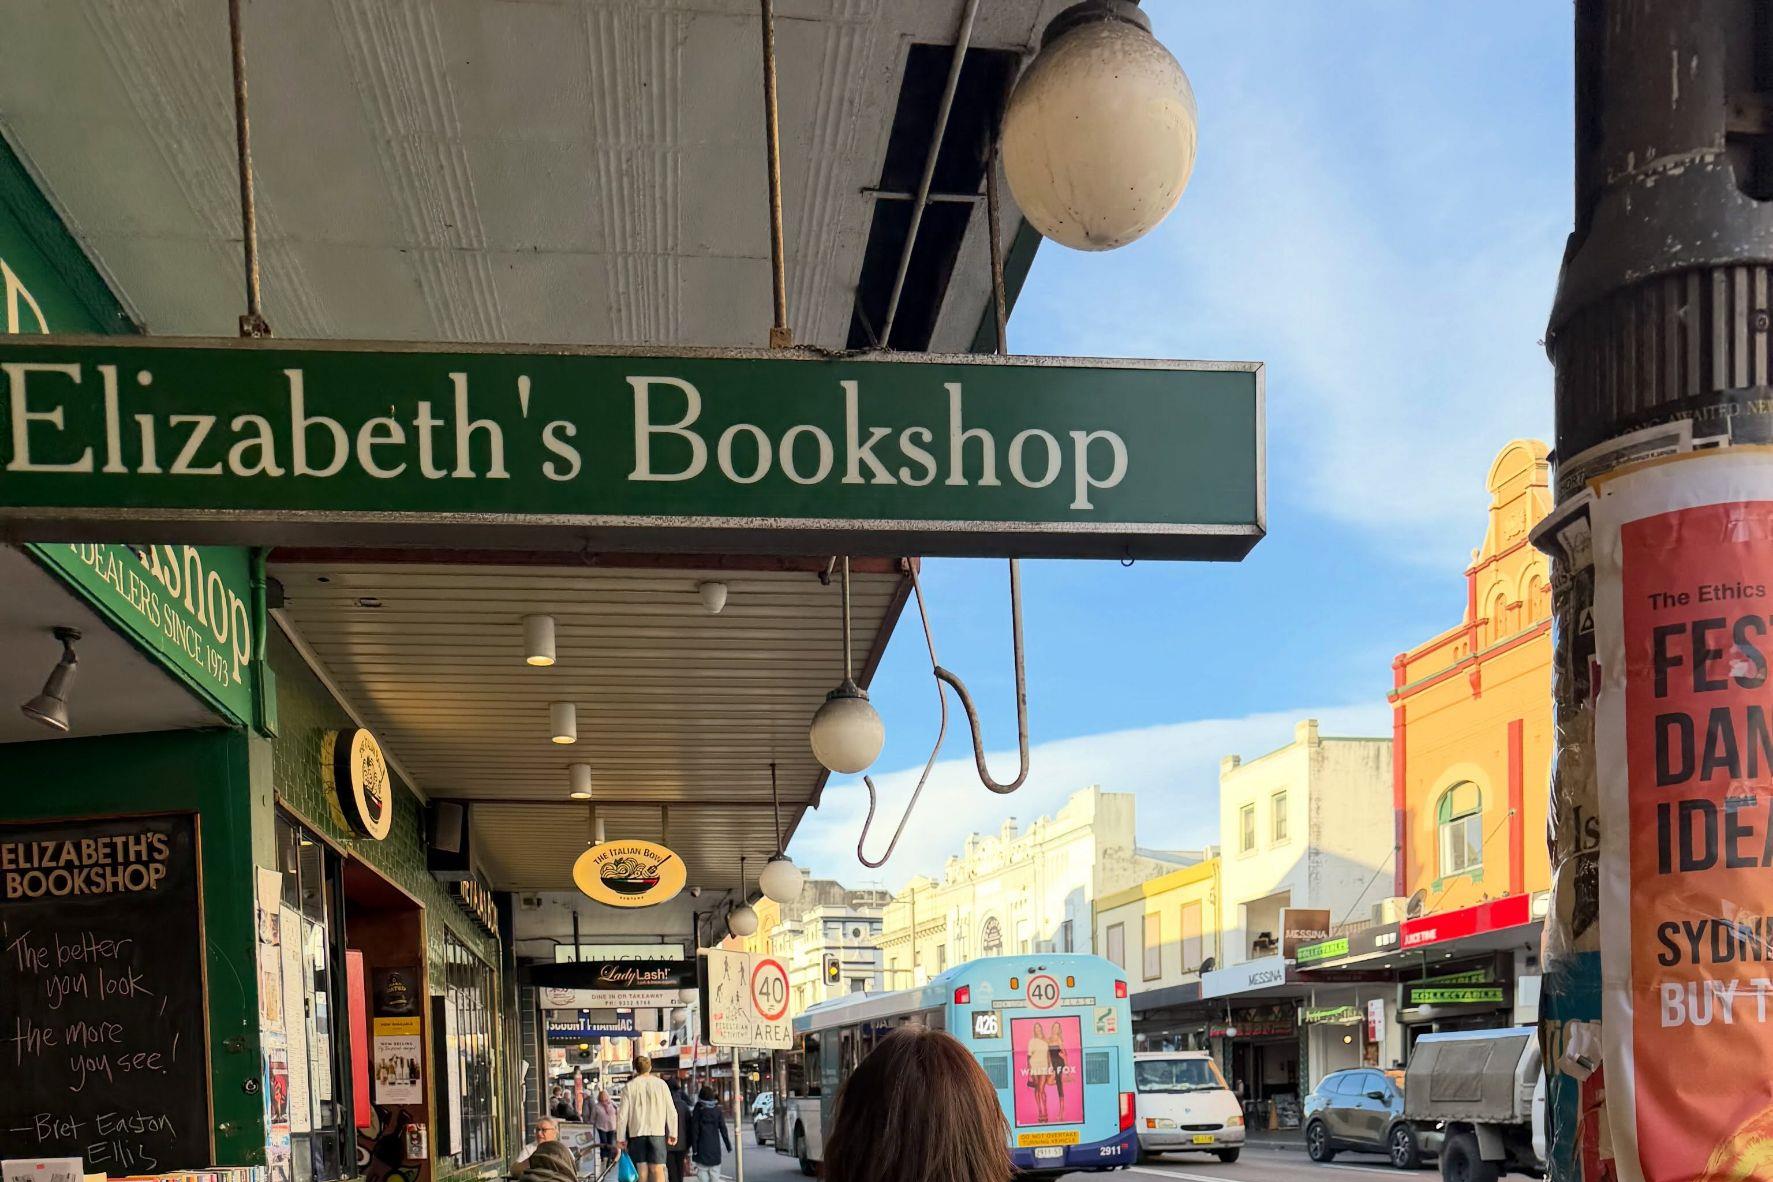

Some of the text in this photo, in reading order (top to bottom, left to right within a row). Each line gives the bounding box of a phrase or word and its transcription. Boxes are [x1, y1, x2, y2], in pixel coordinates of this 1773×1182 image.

[2, 362, 1129, 510] Elizabeth's Bookshop
[1648, 581, 1767, 611] The Ethics
[80, 544, 229, 687] DEALERS SINCE 1973
[1653, 614, 1773, 699] FES
[1, 832, 170, 870] ELIZABETH'S
[1657, 796, 1773, 875] IDE
[592, 852, 609, 865] THE
[609, 847, 642, 858] ITALIAN
[6, 863, 167, 899] BOOKSHOP
[55, 930, 133, 968] better
[600, 964, 636, 987] Lady
[758, 976, 784, 1004] 40
[1031, 984, 1056, 1001] 40
[1661, 977, 1773, 1028] BUY T
[9, 1016, 124, 1067] the more
[754, 1024, 791, 1042] AREA
[1056, 1065, 1077, 1075] FOX
[1044, 1131, 1078, 1139] OVERTAKE
[1100, 1145, 1122, 1156] 2911
[87, 1139, 158, 1171] Ellis
